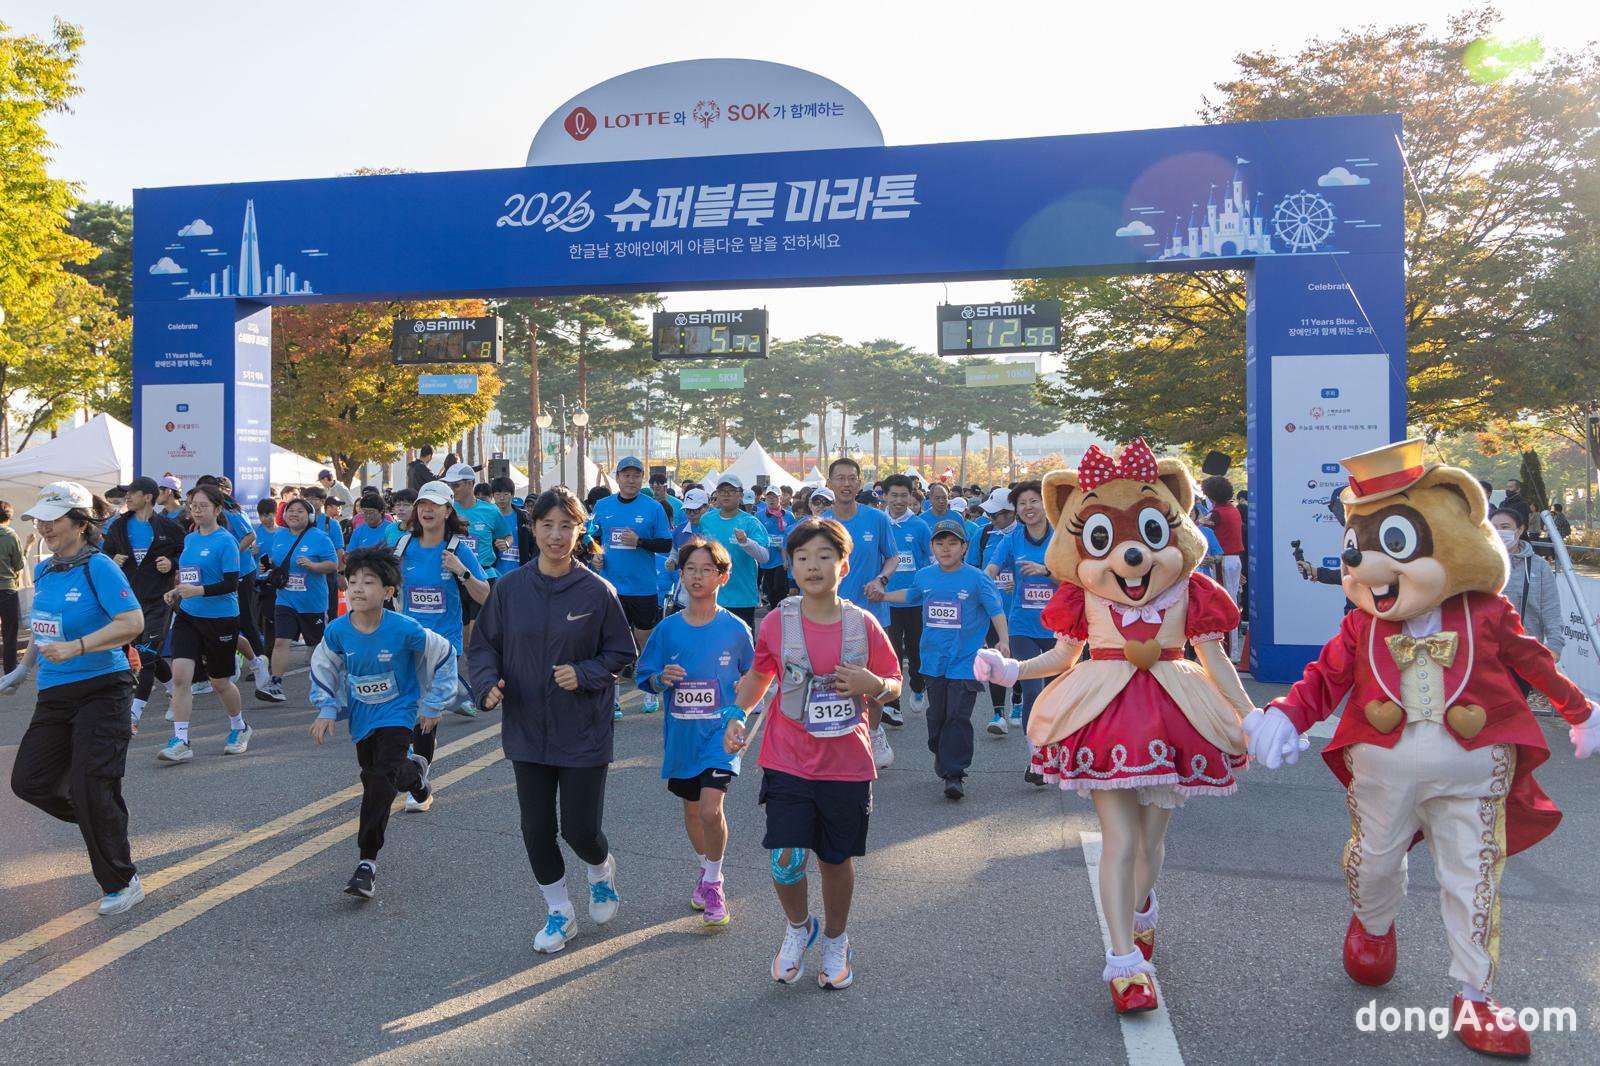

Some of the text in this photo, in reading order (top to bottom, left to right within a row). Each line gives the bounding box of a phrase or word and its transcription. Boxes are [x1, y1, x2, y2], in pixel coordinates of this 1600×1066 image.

[790, 102, 845, 119] 함께하는
[496, 174, 922, 233] 2026 슈퍼블루 마라톤
[614, 240, 683, 258] 장애인에게
[687, 236, 745, 255] 아름다운
[749, 235, 778, 252] 말을
[782, 233, 841, 251] 전하세요
[976, 304, 1036, 317] SAMIK
[688, 312, 743, 324] SAMIK
[1310, 318, 1335, 326] Years
[426, 320, 476, 331] SAMIK
[1288, 328, 1320, 337] 장애인과
[1322, 327, 1337, 336] 함께
[413, 594, 440, 603] 3054
[1027, 590, 1051, 599] 4146
[930, 608, 956, 618] 3082
[32, 622, 57, 635] 2074
[1564, 625, 1590, 642] Olympics
[356, 682, 389, 695] 1028
[676, 690, 713, 704] 3046
[814, 703, 853, 719] 3125
